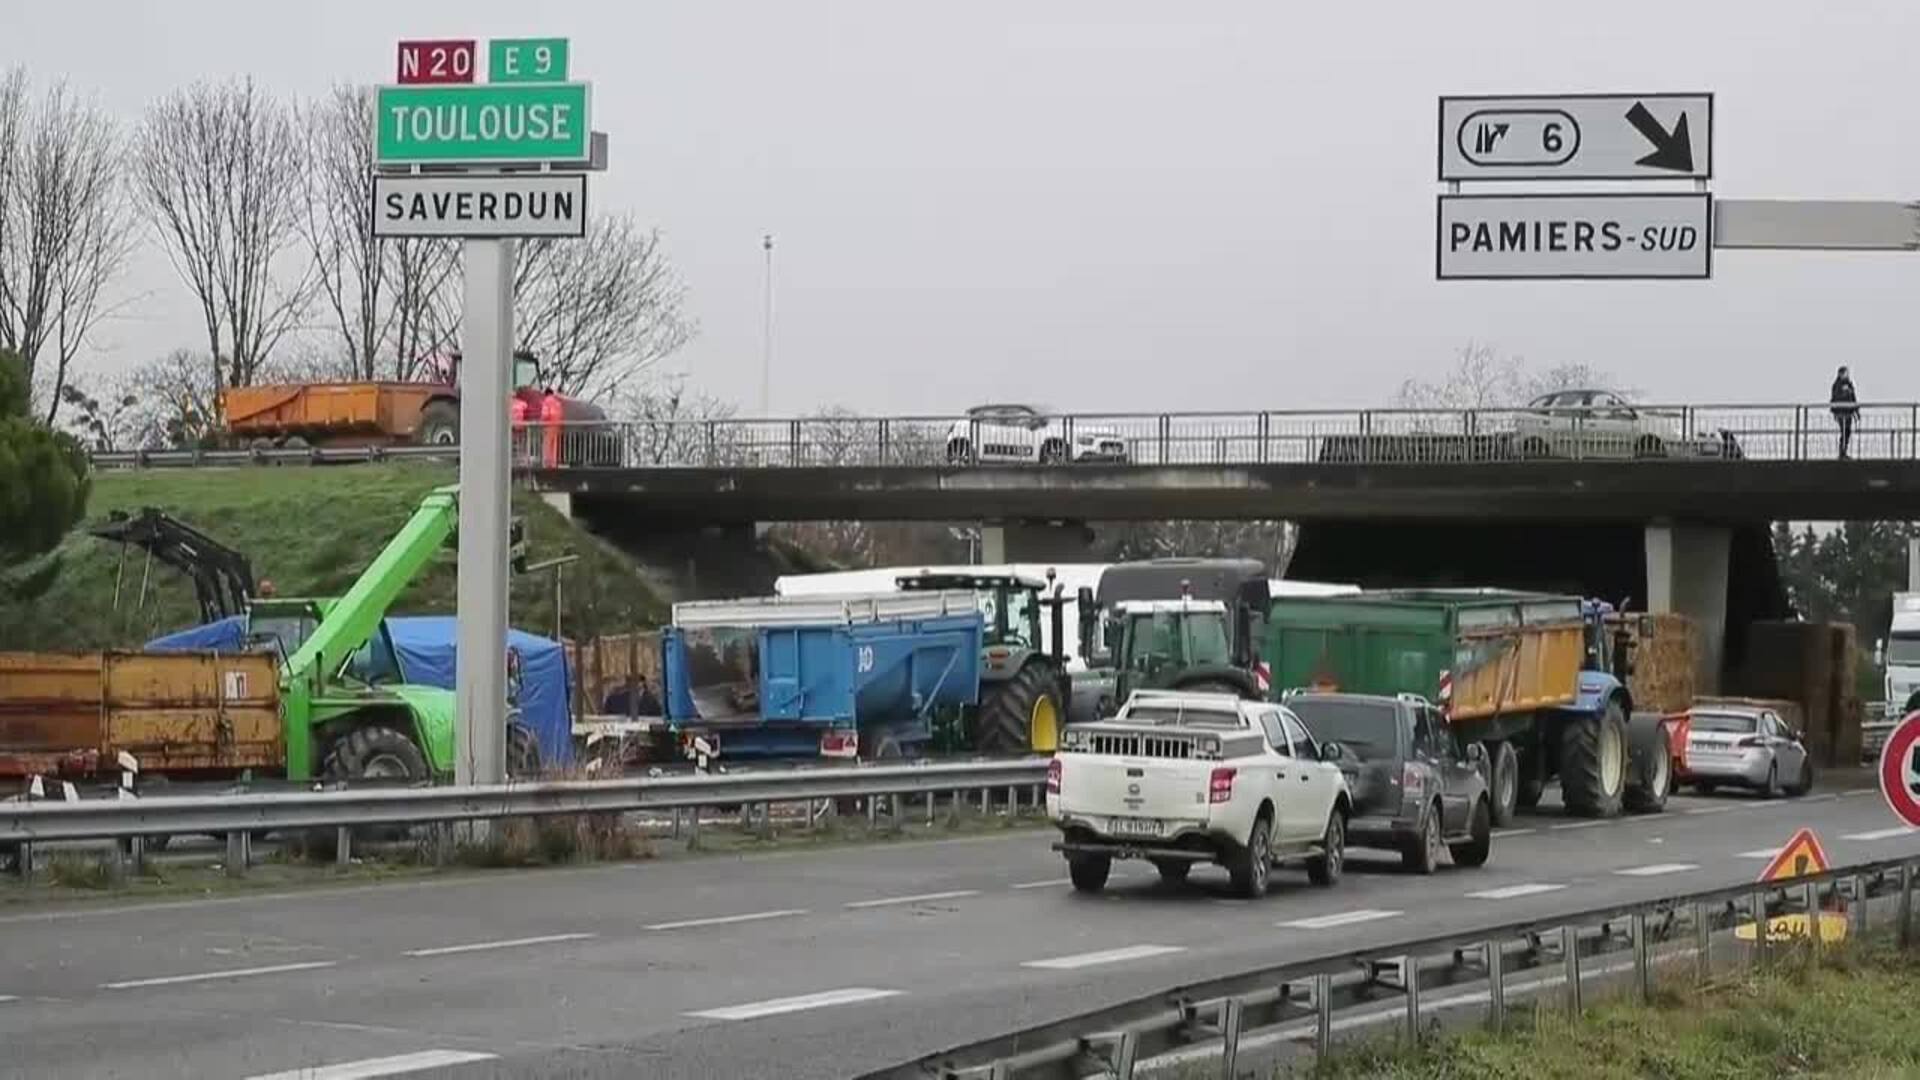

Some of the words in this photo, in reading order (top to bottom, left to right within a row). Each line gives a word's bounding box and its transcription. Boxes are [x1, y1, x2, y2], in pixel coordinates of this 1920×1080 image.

[402, 48, 420, 77] N
[430, 48, 470, 76] 20
[505, 48, 519, 74] E
[535, 47, 551, 73] 9
[391, 104, 571, 141] TOULOUSE
[1543, 123, 1562, 152] 6
[386, 192, 573, 220] SAVERDUN
[1451, 222, 1697, 252] PAMIERS-SUD
